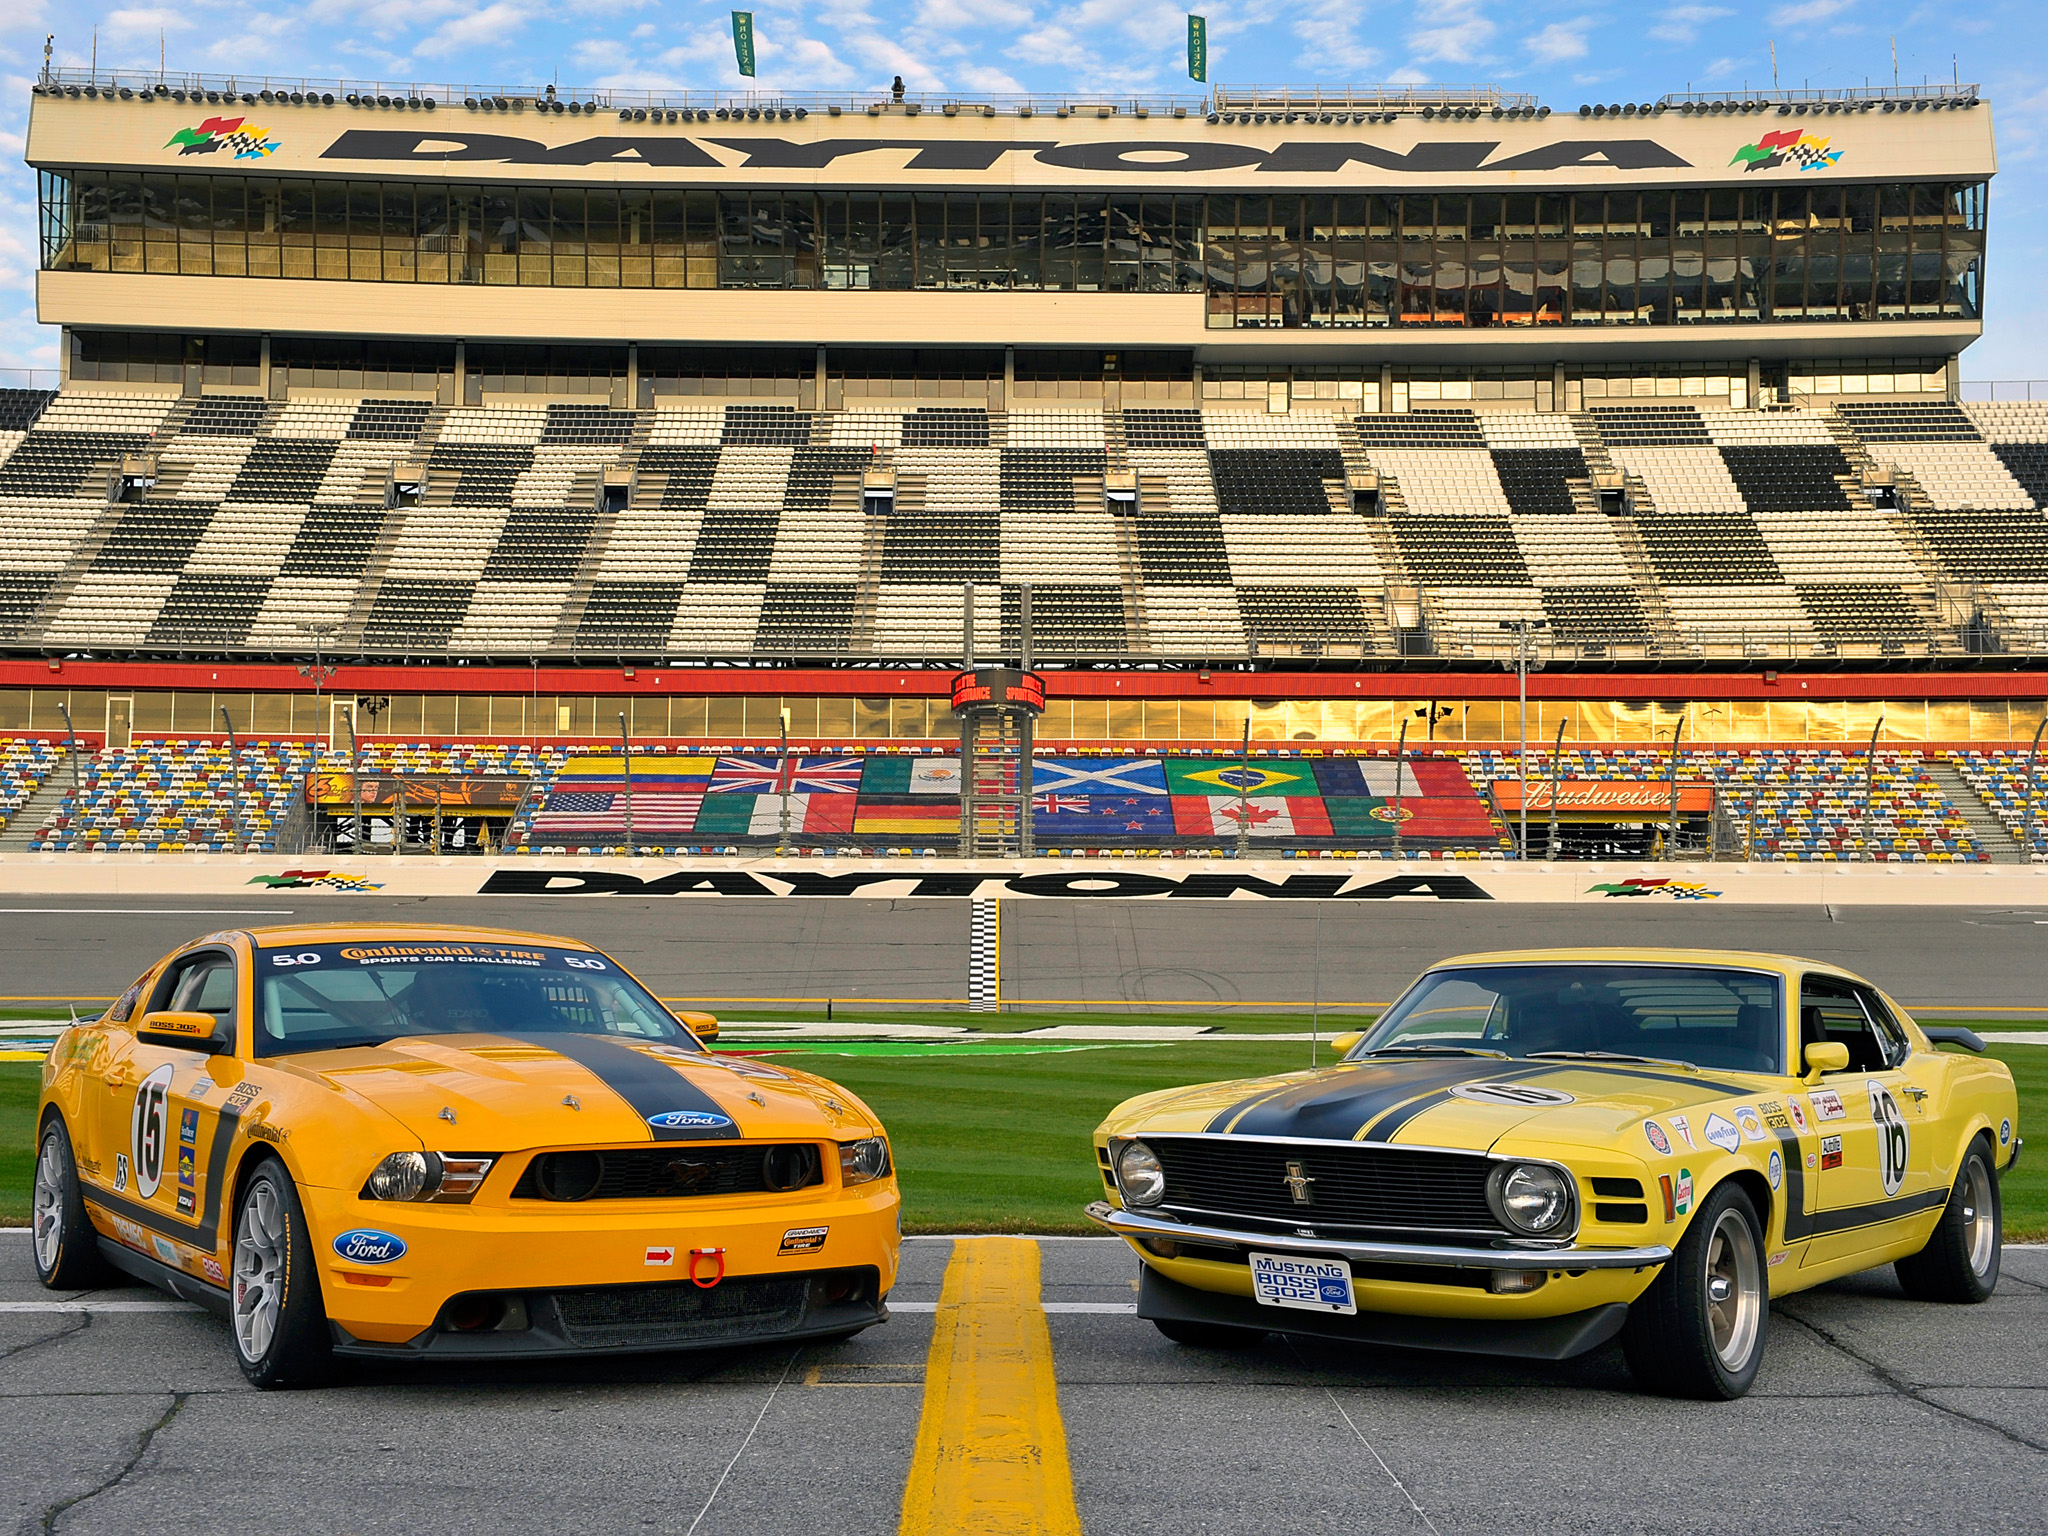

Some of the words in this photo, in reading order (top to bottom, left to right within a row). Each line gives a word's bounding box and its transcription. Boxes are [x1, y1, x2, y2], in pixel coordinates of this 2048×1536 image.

[319, 129, 1693, 171] DAYTONA
[1524, 781, 1681, 808] Budweiser
[477, 870, 1495, 899] DAYTONA
[272, 953, 321, 966] 5.0
[340, 946, 474, 960] Continental
[496, 950, 546, 961] TIRE
[360, 956, 419, 965] SPORTS
[458, 956, 541, 966] CHALLENGE
[563, 957, 606, 970] 5.0
[149, 1020, 174, 1029] BOSS
[234, 1081, 262, 1096] BOSS
[1465, 1085, 1562, 1104] 16
[1758, 1100, 1782, 1114] BOSS
[666, 1114, 716, 1125] Ford
[1768, 1115, 1788, 1129] 302
[137, 1080, 167, 1182] 15
[247, 1121, 282, 1143] Continental
[1707, 1126, 1737, 1140] GOODYEAR
[1873, 1090, 1907, 1186] 16
[116, 1155, 127, 1190] GS
[1677, 1183, 1690, 1200] Castrol
[346, 1233, 390, 1258] Ford
[783, 1236, 818, 1247] Continental
[202, 1256, 224, 1280] BBS
[281, 1213, 292, 1311] CONTINENTAL
[1256, 1259, 1343, 1278] MUSTANG
[1257, 1272, 1318, 1290] BOSS
[1263, 1285, 1316, 1300] 302
